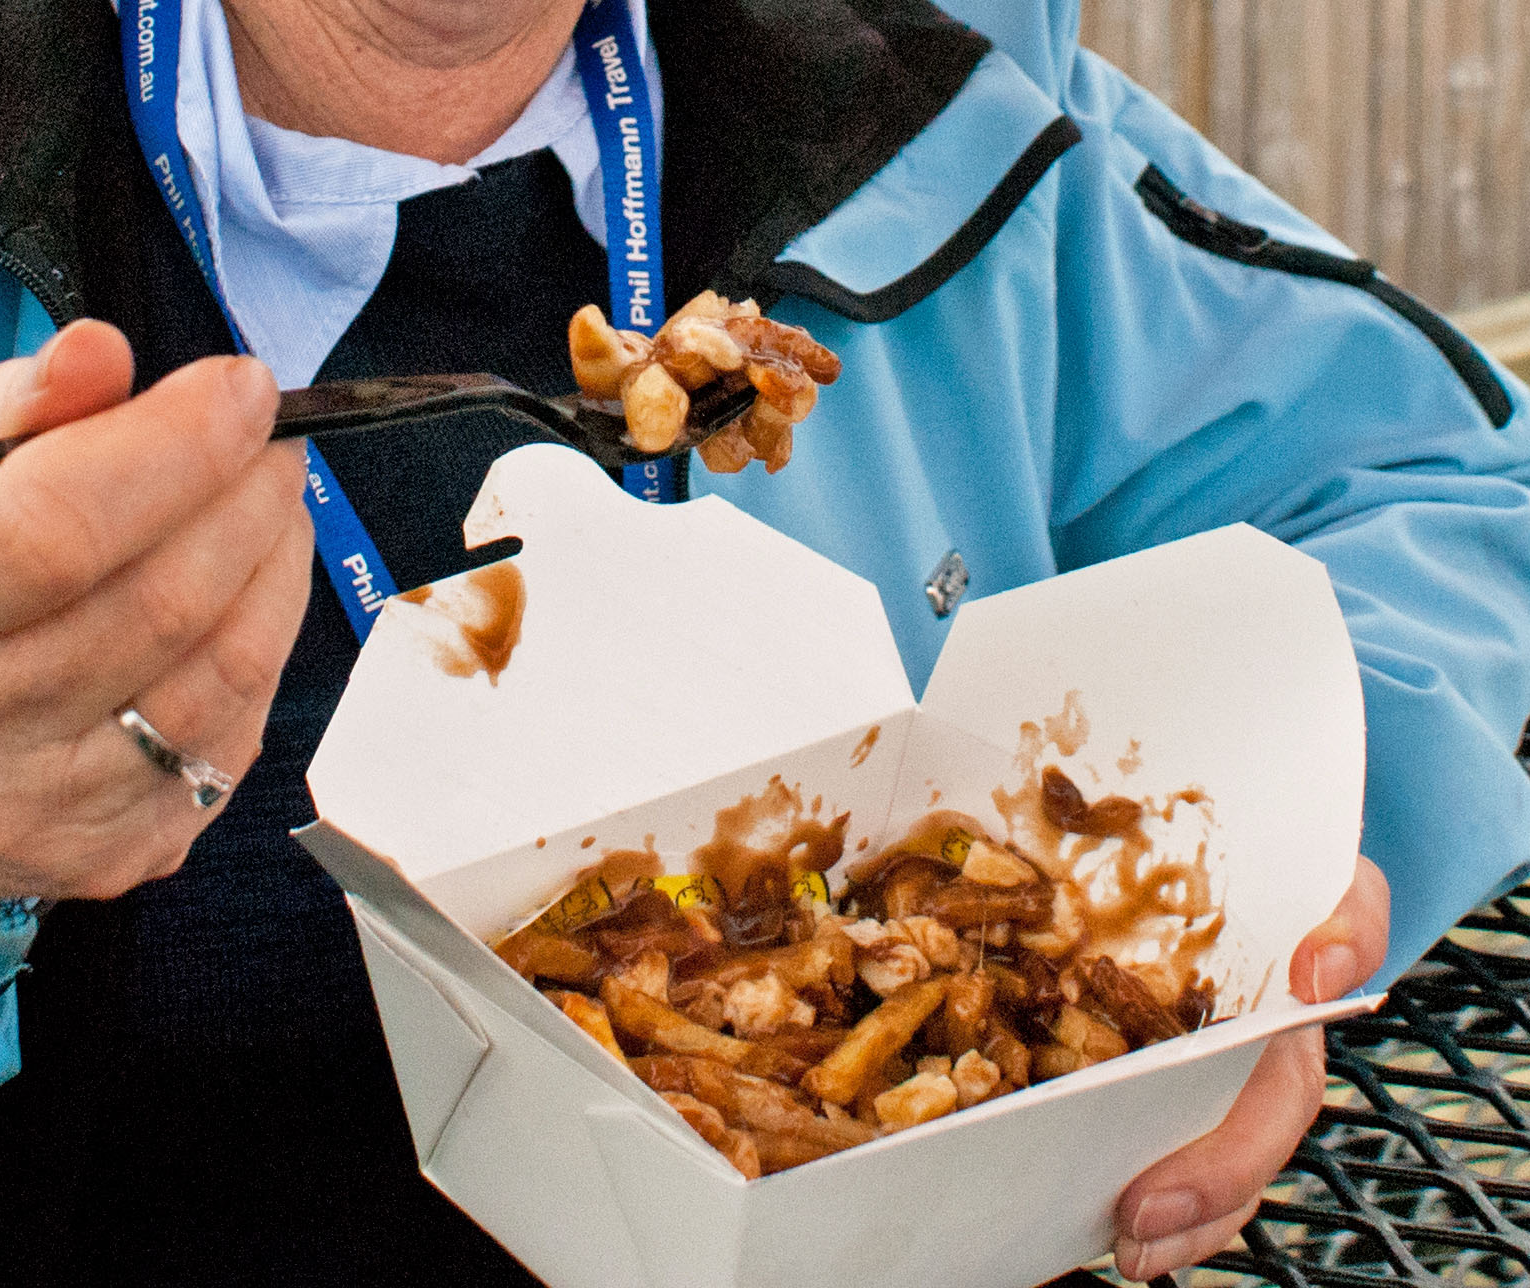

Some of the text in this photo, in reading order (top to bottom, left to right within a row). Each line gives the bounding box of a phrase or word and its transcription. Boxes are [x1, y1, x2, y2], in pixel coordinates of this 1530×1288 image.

[593, 35, 633, 111] Travel
[154, 153, 185, 211] Phil
[619, 117, 649, 262] Hoffmann
[628, 270, 653, 327] Phil
[342, 553, 385, 613] Phil
